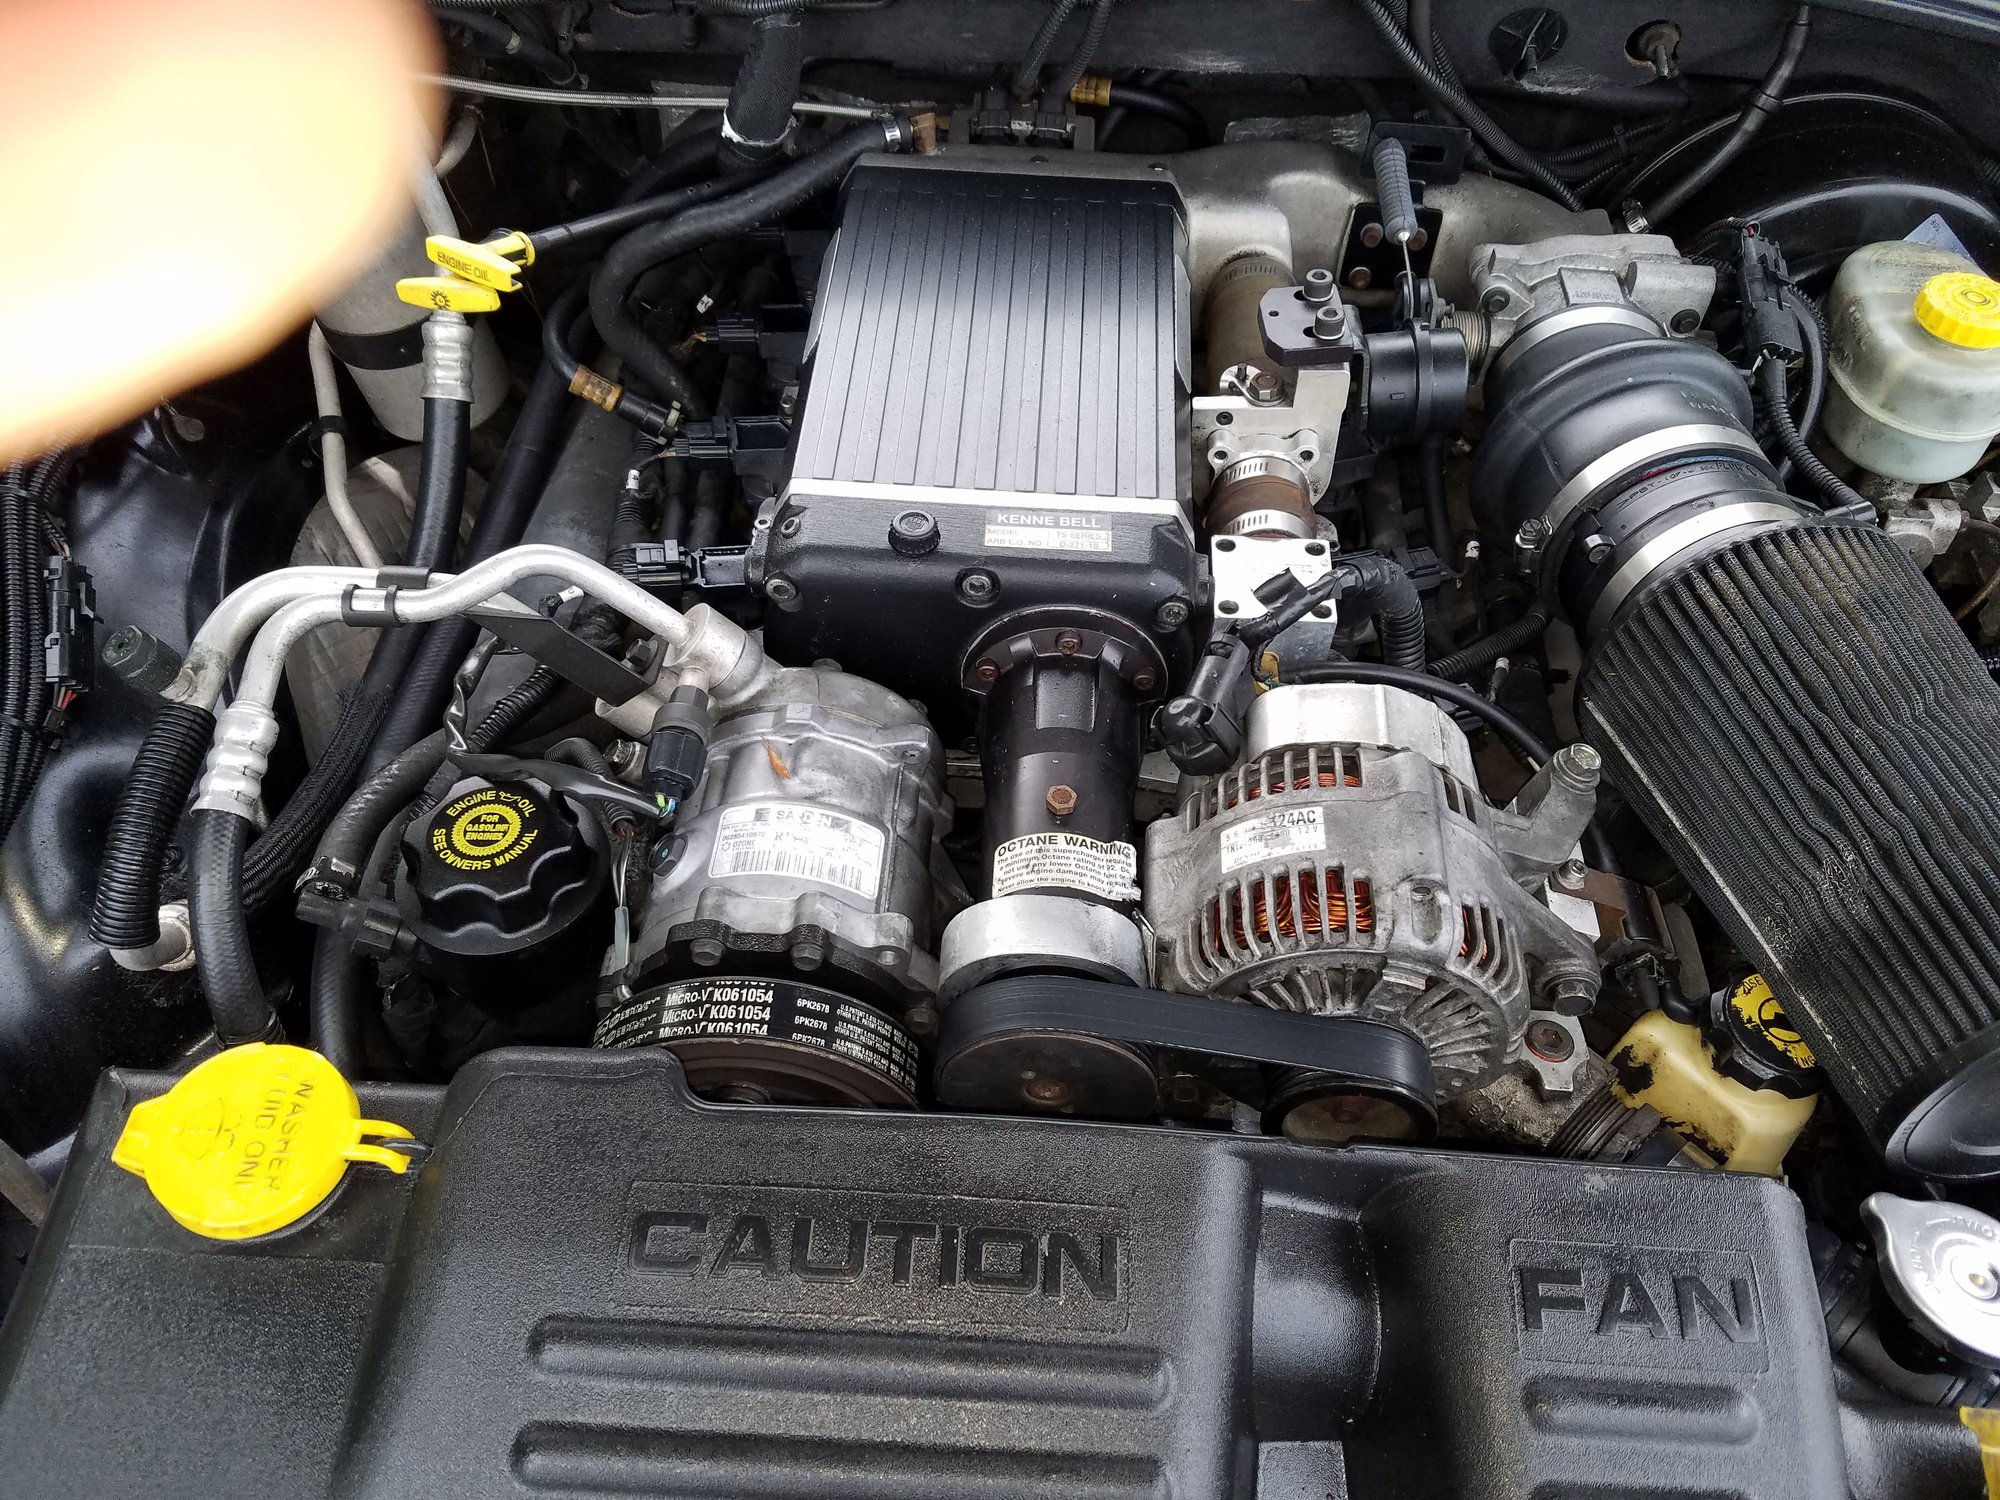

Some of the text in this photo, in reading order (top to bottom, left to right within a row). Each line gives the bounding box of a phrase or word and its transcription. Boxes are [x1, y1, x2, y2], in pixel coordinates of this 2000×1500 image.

[437, 251, 490, 282] ENGINE OIL
[997, 513, 1101, 528] KENNE BELL
[988, 528, 1018, 536] MODEL
[1070, 532, 1102, 540] SERIES
[446, 790, 537, 818] ENGINE OIL
[480, 814, 500, 823] FOR
[465, 832, 504, 840] ENGINES
[432, 828, 538, 871] SEE OWNERS MANUAL
[998, 835, 1131, 859] OCTANE WARNING
[1010, 852, 1023, 860] use
[1035, 846, 1051, 854] this
[1053, 847, 1105, 863] supercharger
[1004, 855, 1039, 869] minimum
[1073, 856, 1096, 868] rating
[1004, 867, 1015, 876] not
[1074, 863, 1102, 875] Octane
[1016, 878, 1035, 886] allow
[1026, 868, 1053, 876] engine
[1055, 868, 1088, 878] damage
[1089, 874, 1104, 885] may
[712, 987, 774, 1004] K061054
[709, 1004, 771, 1021] K061054
[796, 998, 830, 1014] 6PK2678
[706, 1021, 769, 1036] K061054
[794, 1015, 828, 1031] 6PK2678
[791, 1032, 826, 1048] 6PK2678
[628, 1210, 1121, 1300] CAUTION
[1518, 1265, 1761, 1344] FAN
